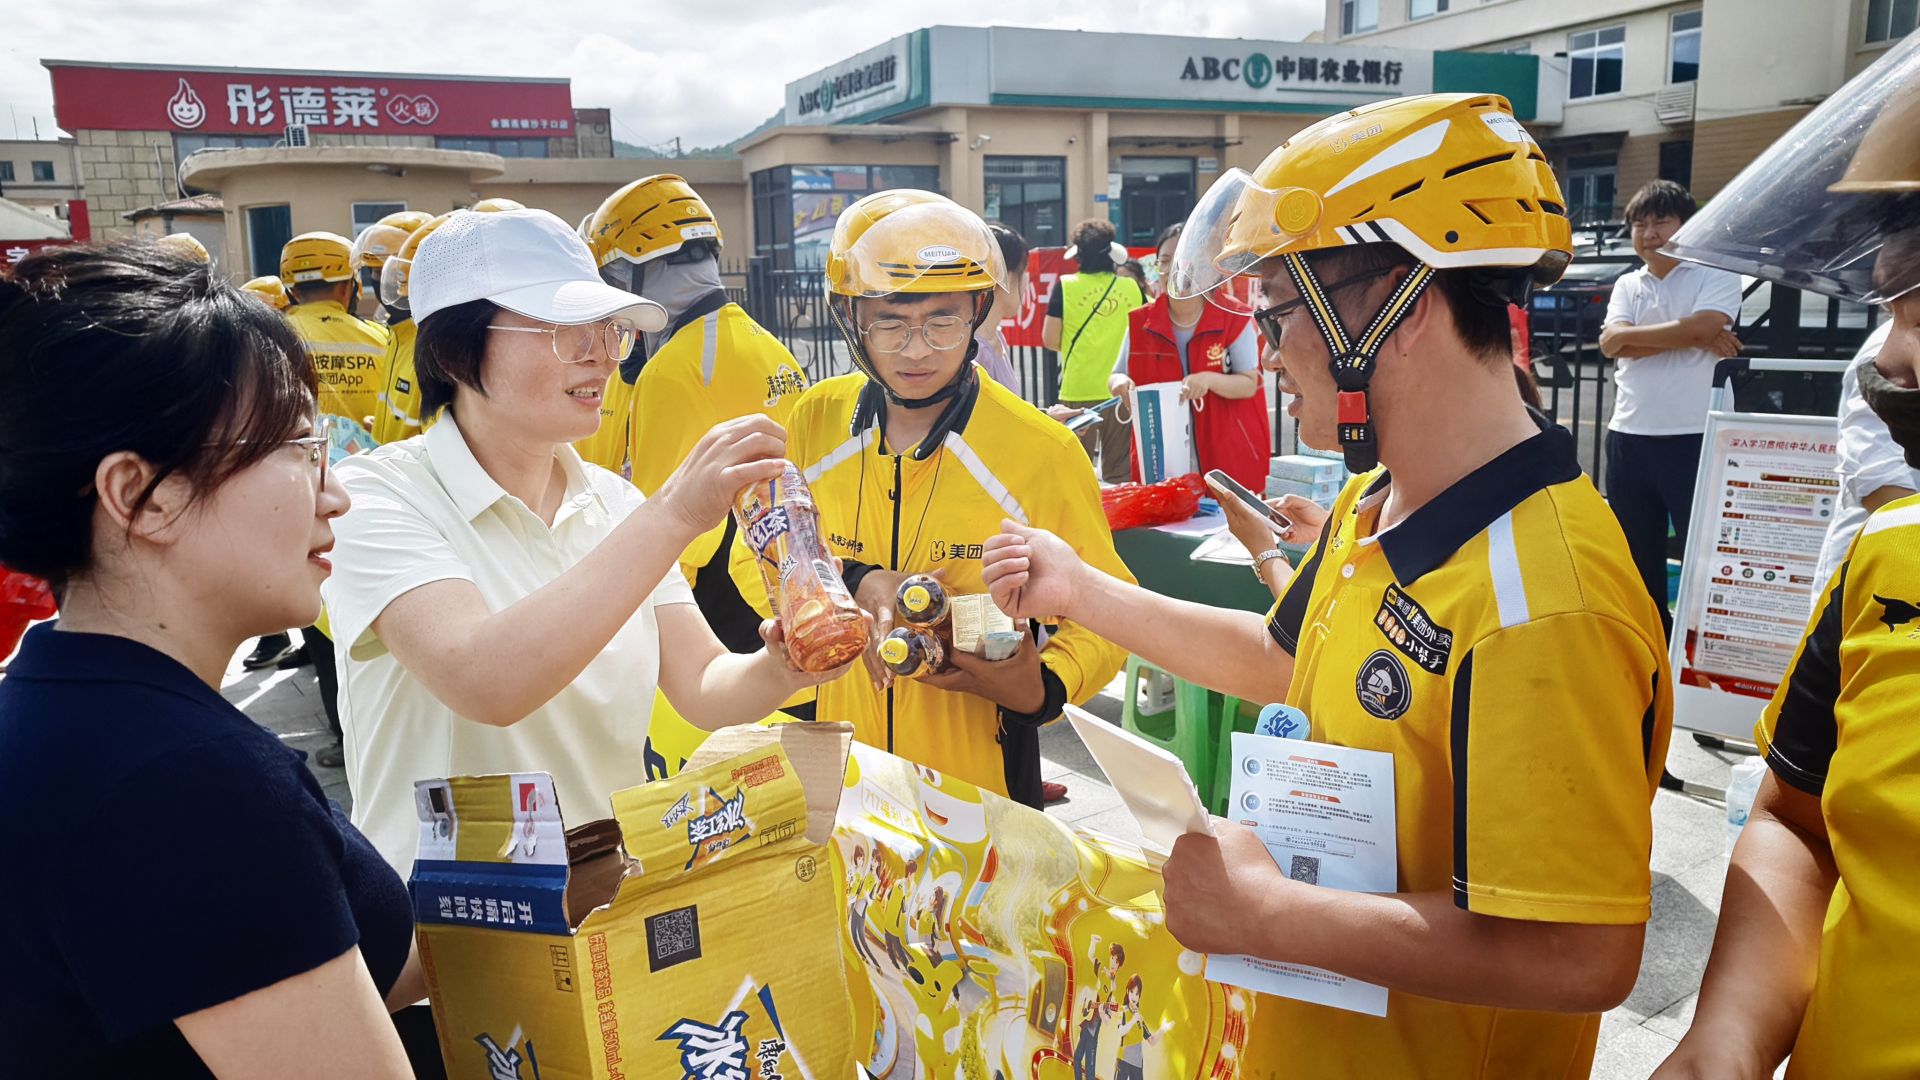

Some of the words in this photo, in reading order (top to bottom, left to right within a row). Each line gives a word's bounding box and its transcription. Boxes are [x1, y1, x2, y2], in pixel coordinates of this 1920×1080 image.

[1180, 56, 1240, 81] ABC
[1276, 56, 1403, 85] 中国农业银行
[226, 83, 379, 127] 彤德莱
[394, 96, 433, 116] 火锅
[949, 544, 983, 559] 美团
[1412, 613, 1452, 648] 美团外卖
[689, 792, 745, 845] 冰红茶
[438, 895, 534, 926] 开启痛快时刻
[588, 932, 613, 1000] 柠檬口味茶饮品
